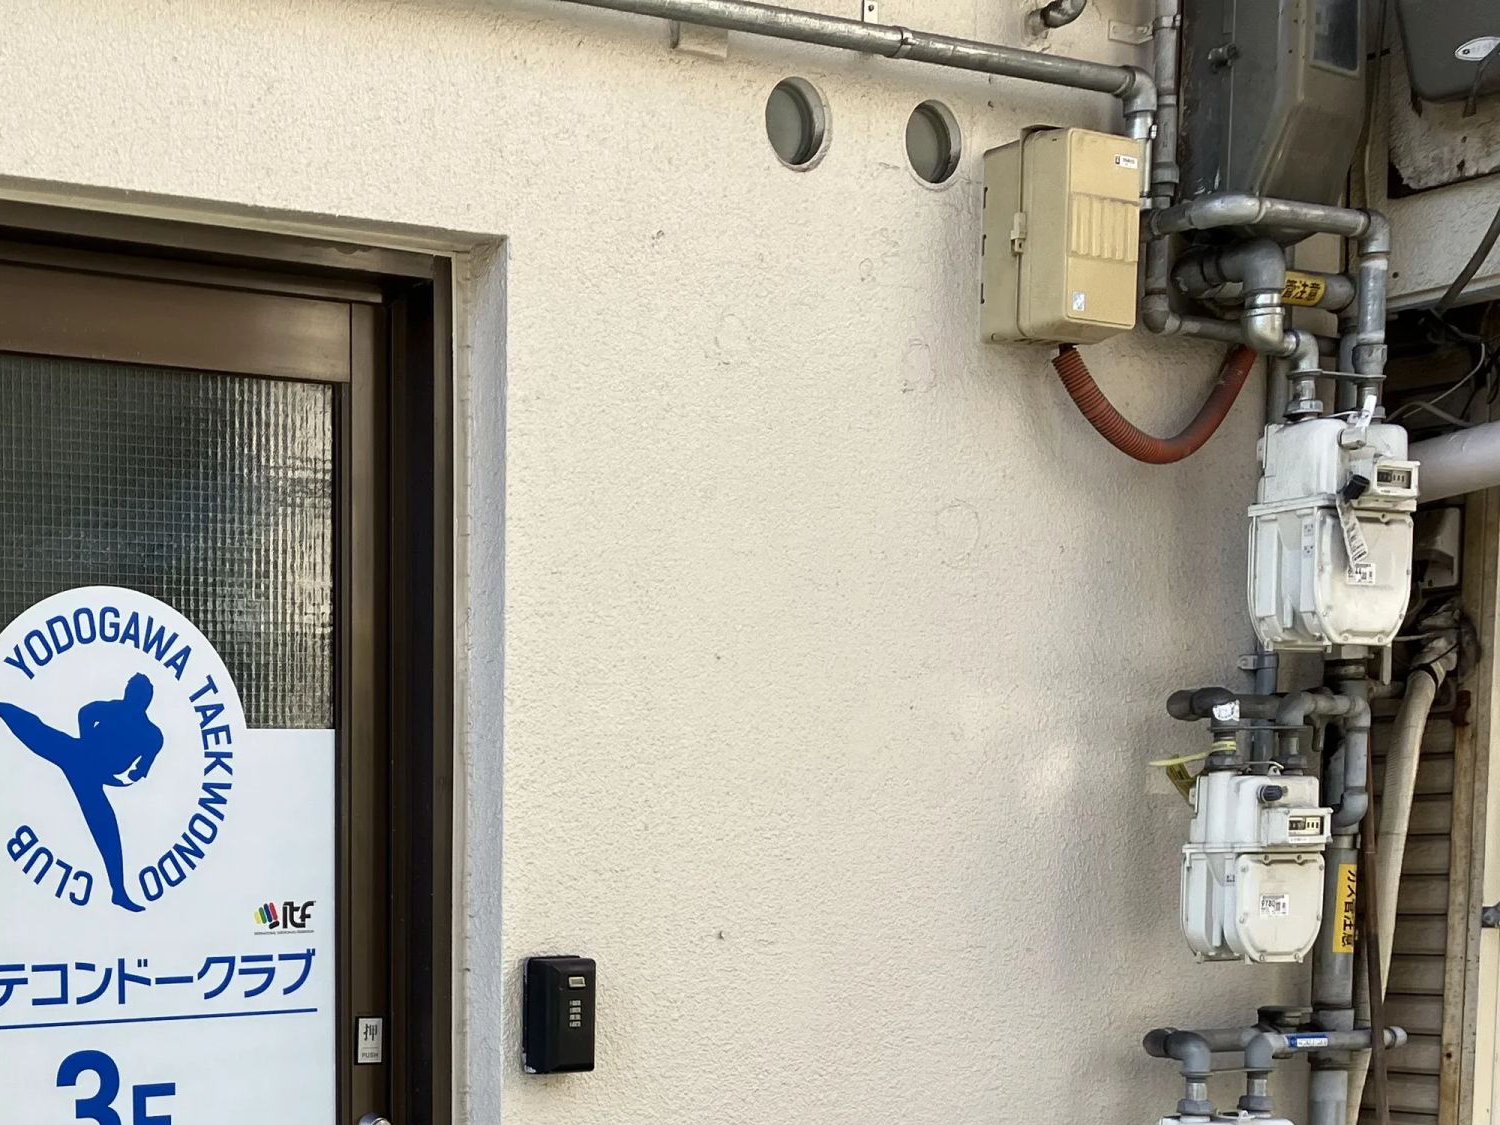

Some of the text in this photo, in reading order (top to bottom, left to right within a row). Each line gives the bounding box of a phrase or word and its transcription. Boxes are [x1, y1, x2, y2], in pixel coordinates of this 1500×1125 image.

[3, 606, 233, 906] YODOGAWA TAEKWONDO CLUB
[363, 1024, 378, 1041] 押
